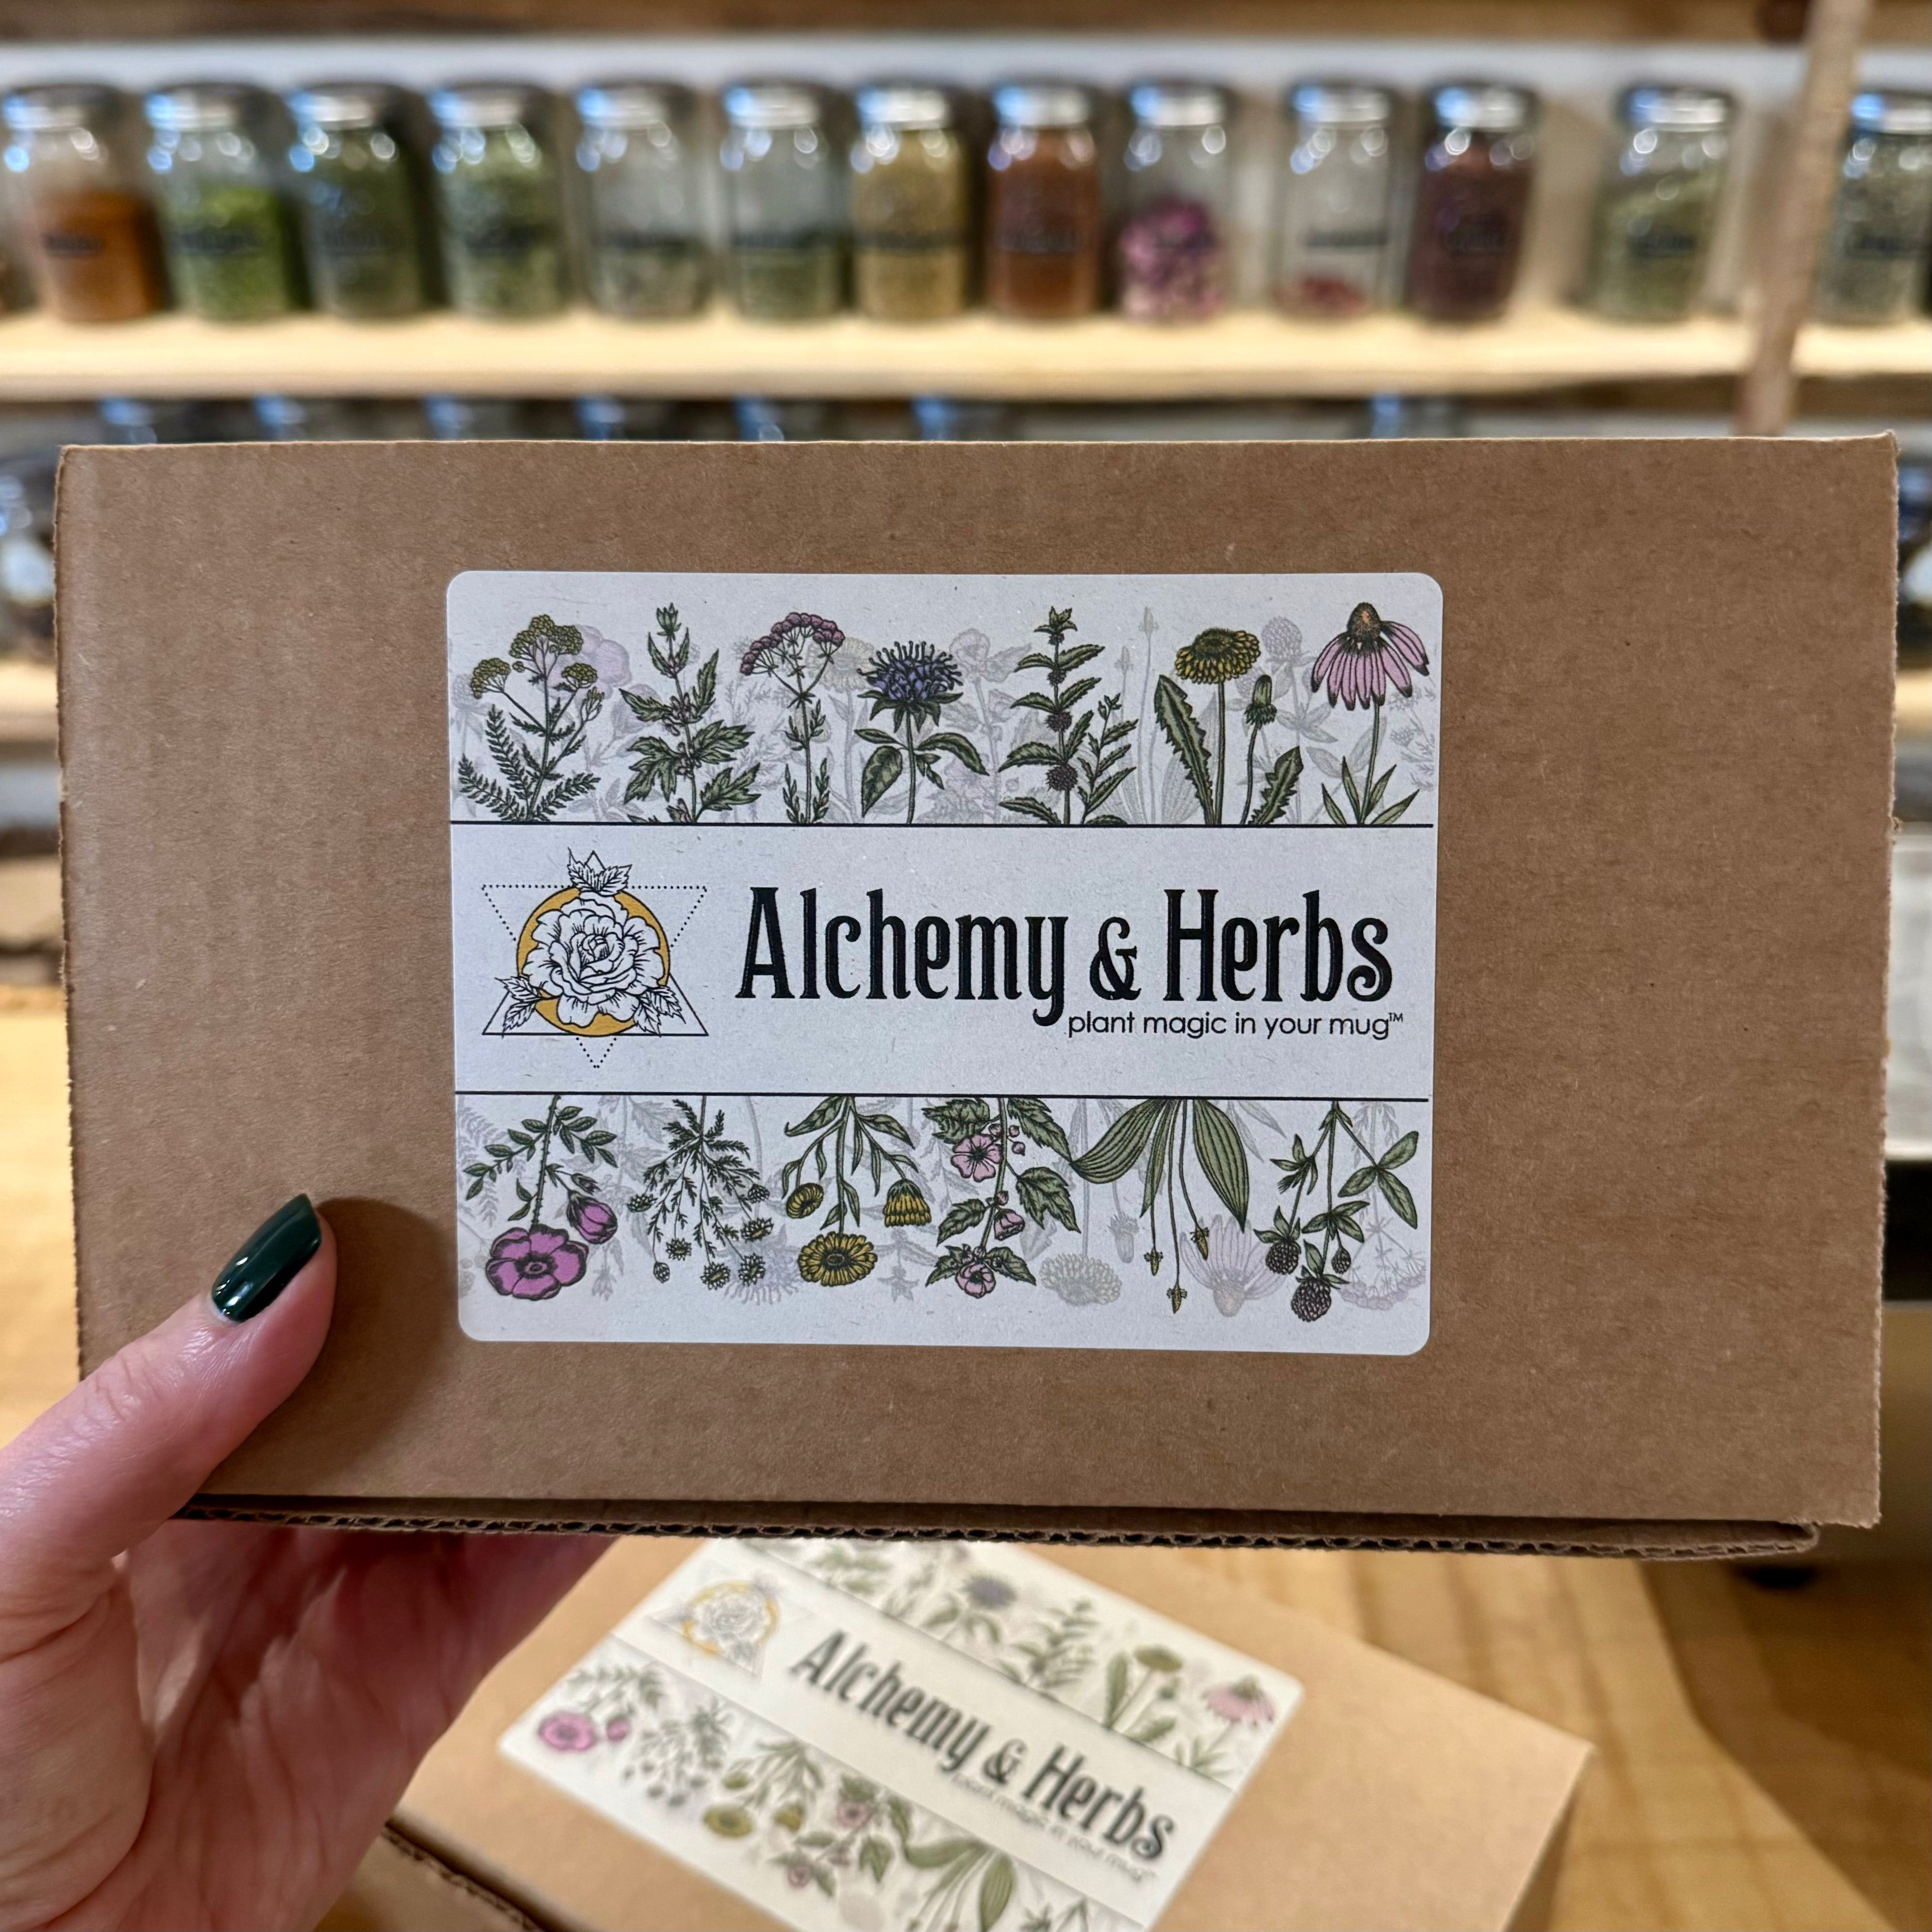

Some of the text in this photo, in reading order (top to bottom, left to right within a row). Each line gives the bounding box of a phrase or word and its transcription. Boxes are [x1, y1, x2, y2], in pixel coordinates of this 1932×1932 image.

[735, 887, 1393, 1027] Alchemy & Herbs
[1068, 1011, 1135, 1038] plant
[1143, 1011, 1227, 1039] magic
[1235, 1012, 1256, 1034] in
[1264, 1017, 1322, 1039] your
[789, 1629, 1176, 1862] Alchemy & Herbs
